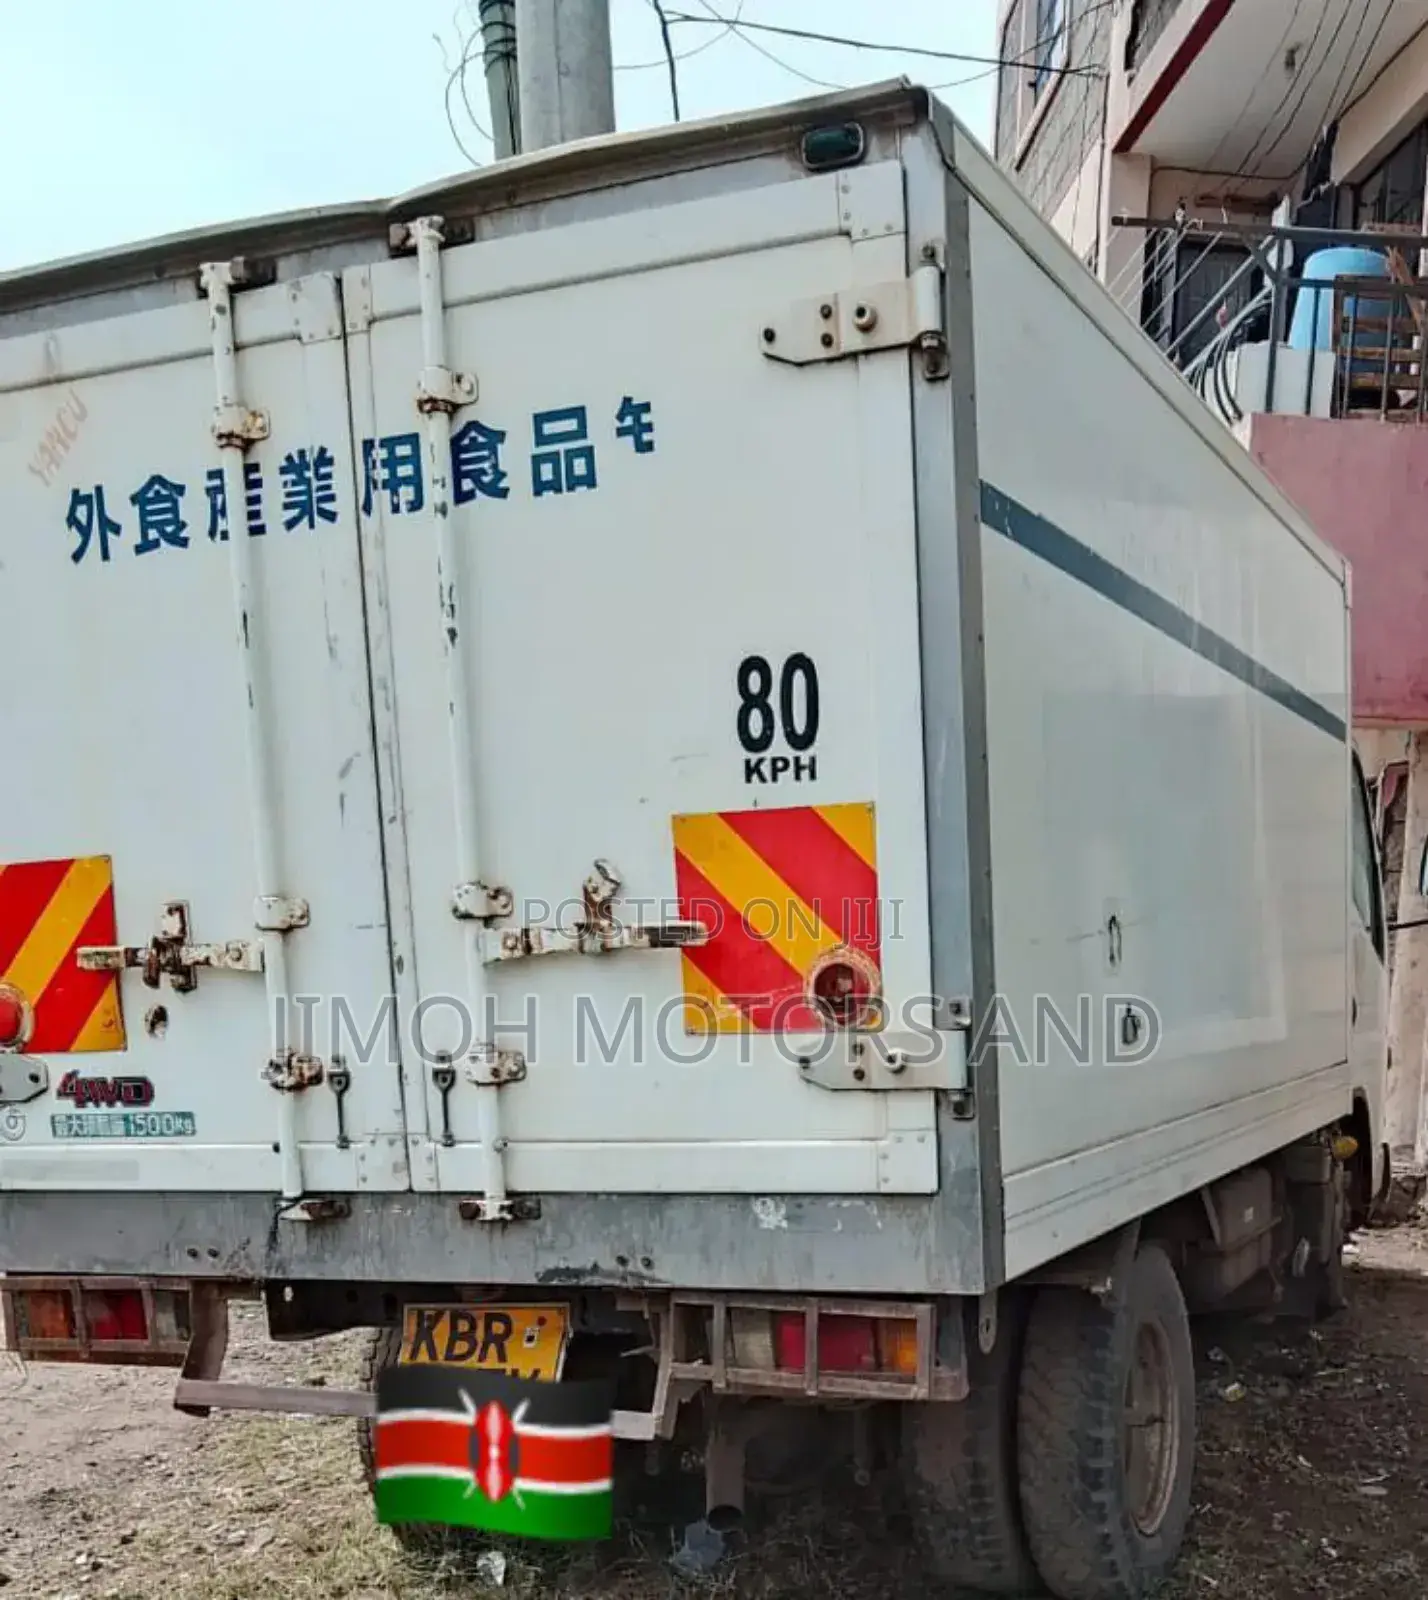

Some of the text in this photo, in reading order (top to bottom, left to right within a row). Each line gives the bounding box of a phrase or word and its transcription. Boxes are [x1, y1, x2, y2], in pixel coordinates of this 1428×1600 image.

[737, 652, 819, 753] 80
[744, 755, 818, 784] KPH
[56, 1069, 155, 1108] 4WD
[408, 1308, 513, 1363] KBR
